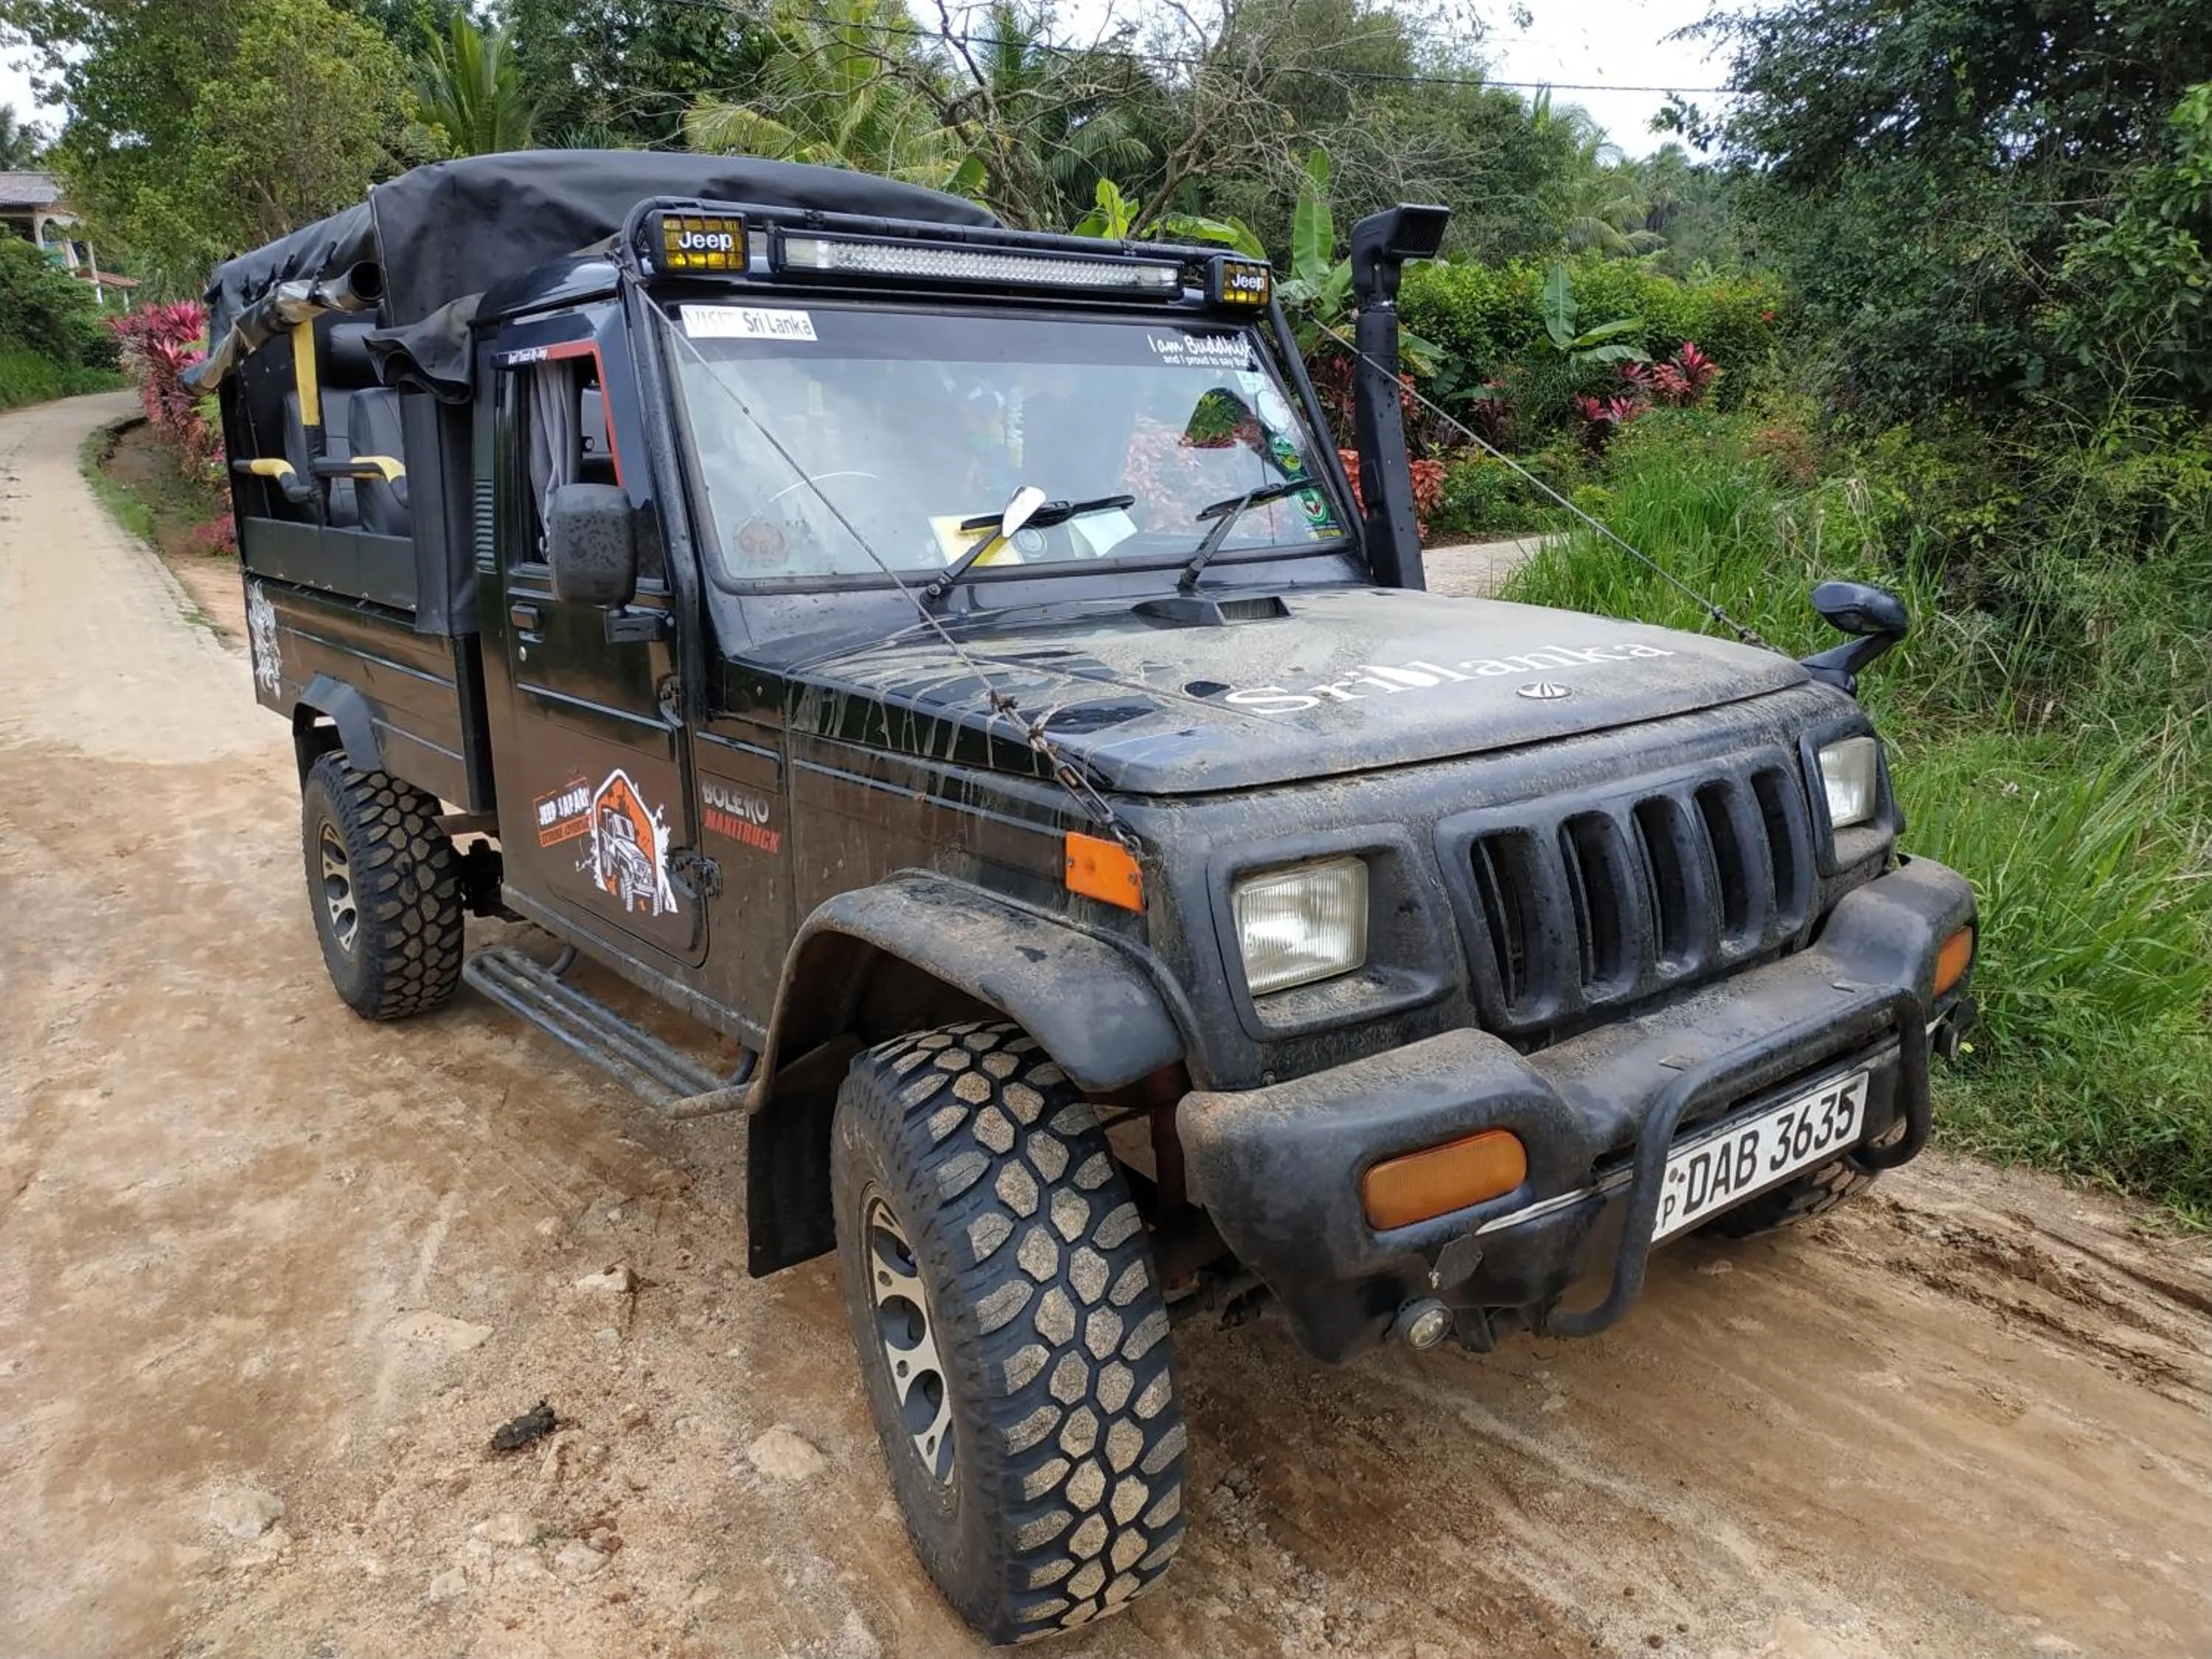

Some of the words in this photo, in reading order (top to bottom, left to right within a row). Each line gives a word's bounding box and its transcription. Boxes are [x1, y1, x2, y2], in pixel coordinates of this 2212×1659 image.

[678, 232, 732, 251] Jeep
[1231, 273, 1264, 291] Jeep
[742, 309, 766, 333] Sri
[765, 313, 812, 335] Lanka
[1225, 669, 1415, 714] Sri
[702, 783, 769, 825] BOLERO
[1682, 1129, 1761, 1217] DAB
[1769, 1084, 1859, 1172] 3635
